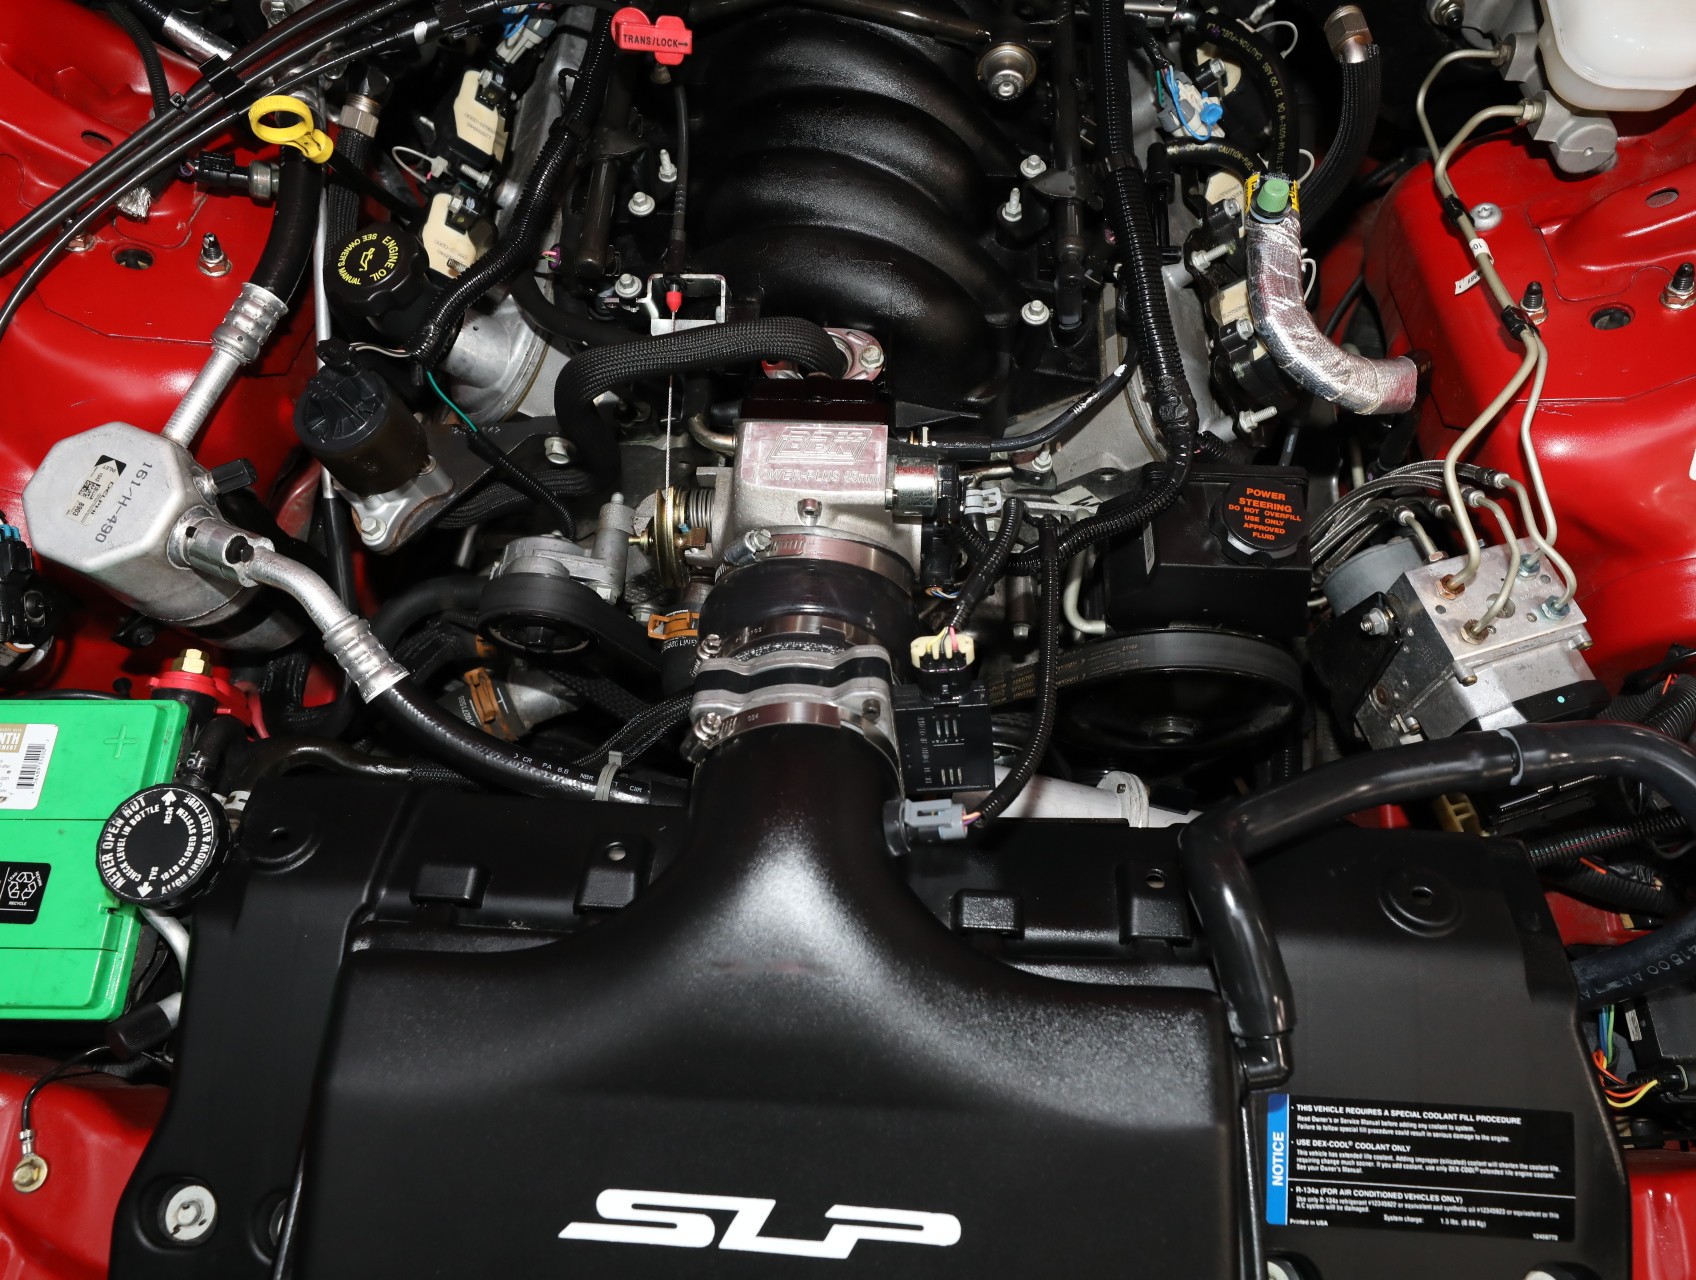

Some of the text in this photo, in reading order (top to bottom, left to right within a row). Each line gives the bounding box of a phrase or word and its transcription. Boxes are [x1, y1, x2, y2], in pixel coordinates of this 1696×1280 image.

[623, 34, 678, 48] TRANS/LOCK
[337, 233, 378, 285] SEE OWNER'S MANUAL
[369, 235, 399, 281] ENGINE OIL
[772, 430, 868, 456] BBK
[753, 468, 840, 482] POWER-PLUS
[1246, 487, 1286, 500] POWER
[1239, 497, 1292, 513] STEERING
[1264, 510, 1301, 521] OVERFILL
[1265, 518, 1285, 526] ONLY
[1243, 522, 1285, 534] APPROVED
[1252, 531, 1275, 540] FLUID
[183, 794, 204, 814] TUBE
[163, 807, 174, 824] RC24
[176, 807, 197, 835] SYSTEM
[198, 812, 212, 834] VENT
[102, 797, 146, 889] NEVER OPEN HOT
[117, 804, 160, 882] CHECK LEVEL IN BOTTLE
[178, 836, 197, 866] CLOSED
[187, 843, 210, 876] ARROW
[148, 866, 159, 881] TVS
[168, 864, 180, 876] LB
[161, 874, 188, 894] ALIGN
[1296, 1103, 1312, 1111] THIS
[1313, 1104, 1344, 1113] VEHICLE
[1345, 1106, 1382, 1115] REQUIRES
[1390, 1109, 1421, 1118] SPECIAL
[1422, 1111, 1457, 1120] COOLANT
[1458, 1113, 1474, 1121] FILL
[1475, 1114, 1521, 1124] PROCEDURE
[1296, 1138, 1310, 1146] USE
[1354, 1141, 1390, 1150] COOLANT
[1390, 1143, 1410, 1152] ONLY
[1271, 1131, 1285, 1187] NOTICE
[1295, 1185, 1319, 1194] R-134a
[1319, 1187, 1337, 1195] (FOR
[1352, 1189, 1403, 1199] CONDITIONED
[1403, 1192, 1439, 1201] VEHICLES
[1440, 1194, 1463, 1203] ONLY)
[558, 1188, 962, 1259] SLP
